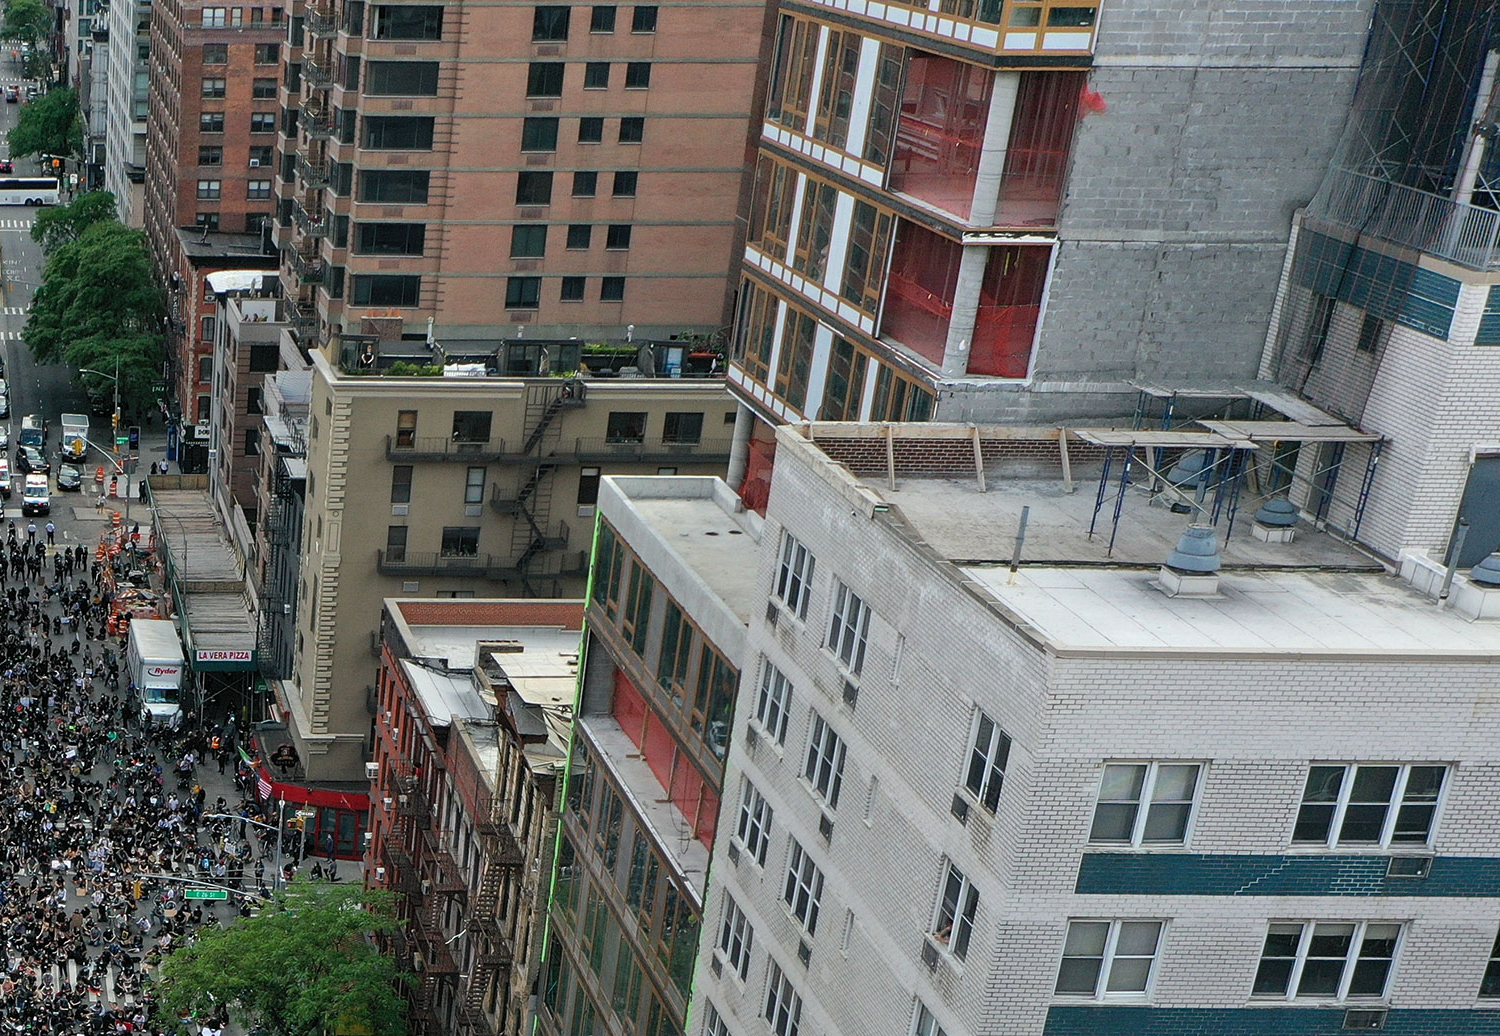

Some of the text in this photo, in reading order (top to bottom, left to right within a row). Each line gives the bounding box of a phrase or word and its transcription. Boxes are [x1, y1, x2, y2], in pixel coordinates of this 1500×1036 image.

[198, 651, 249, 660] LA VERA PIZZA
[155, 667, 178, 675] Ryder
